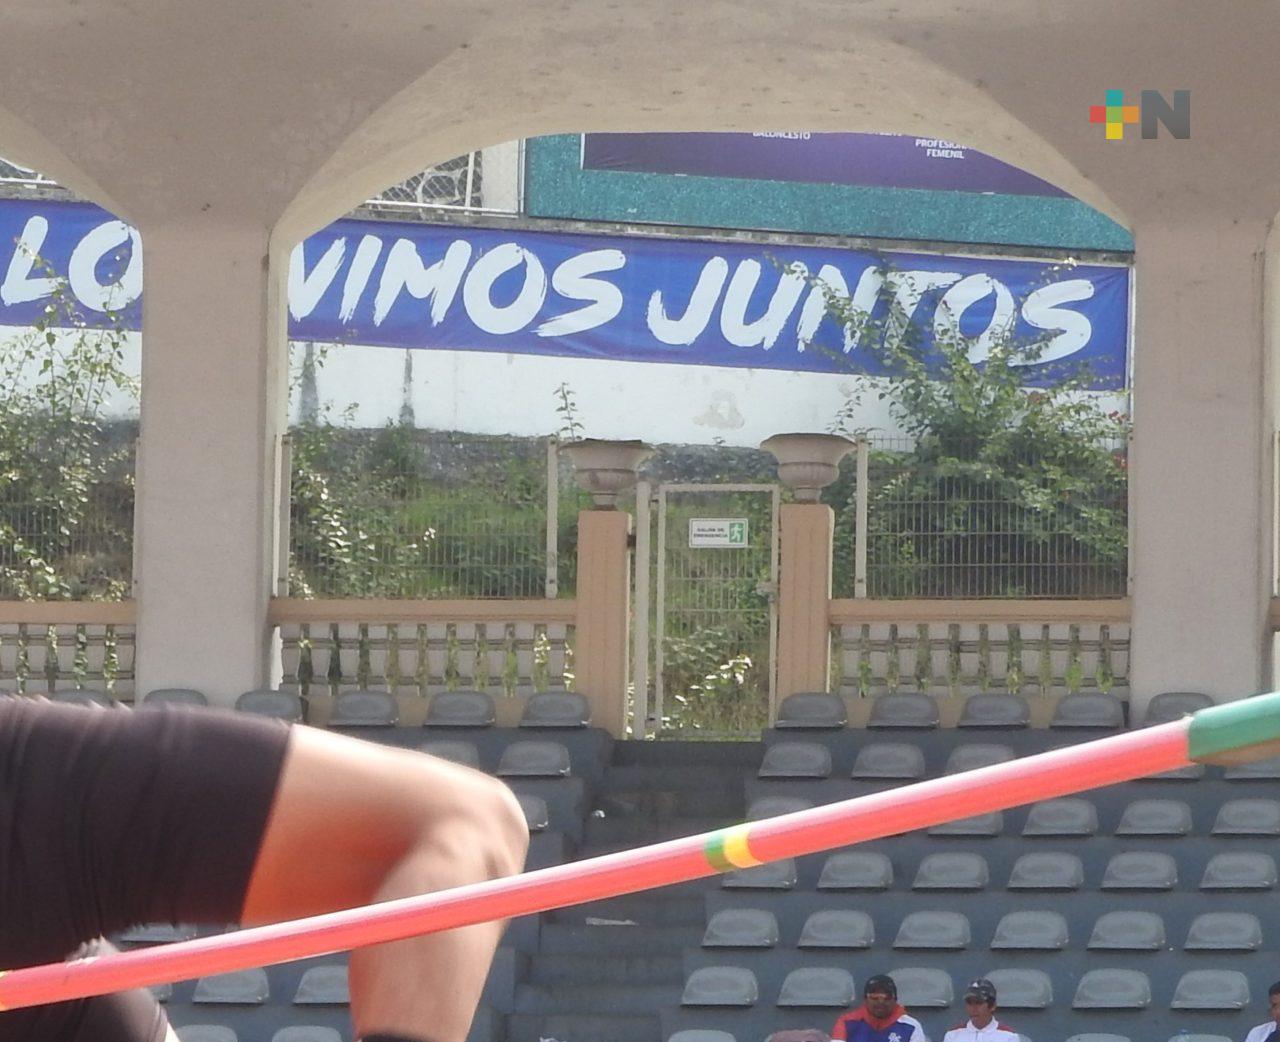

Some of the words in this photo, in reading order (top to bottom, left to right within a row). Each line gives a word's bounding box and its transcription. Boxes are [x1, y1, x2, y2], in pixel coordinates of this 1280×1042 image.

[926, 148, 964, 159] FEMENIL
[0, 215, 144, 312] LO
[646, 257, 1095, 367] JUNTOS
